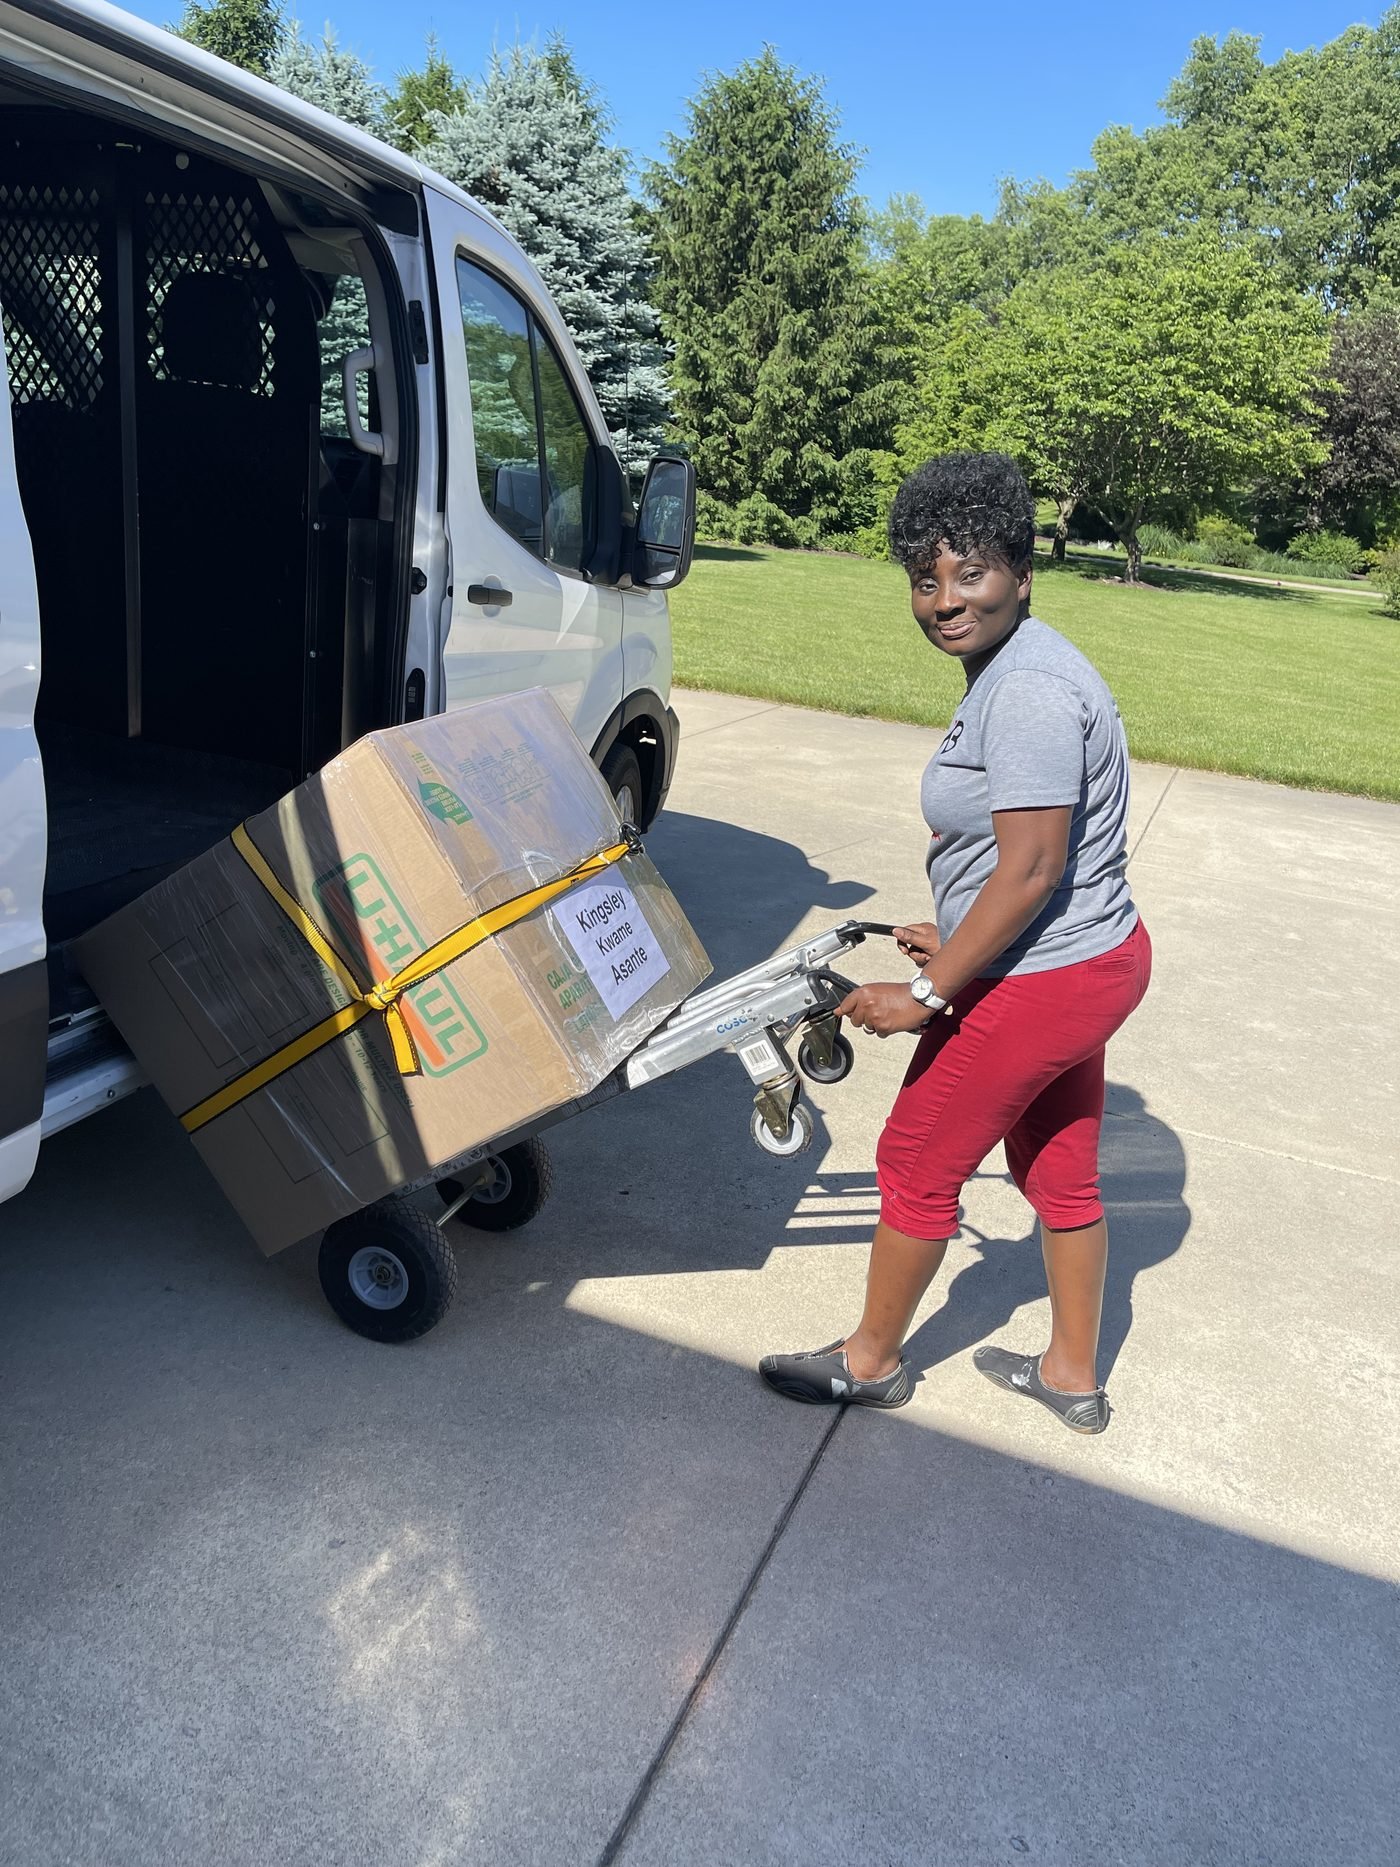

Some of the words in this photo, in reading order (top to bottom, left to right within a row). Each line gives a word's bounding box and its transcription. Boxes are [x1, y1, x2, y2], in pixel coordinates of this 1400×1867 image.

[576, 890, 626, 933] Kingsley
[595, 922, 633, 956] Kwame
[344, 870, 465, 1056] U-HUL
[611, 947, 648, 986] Asante
